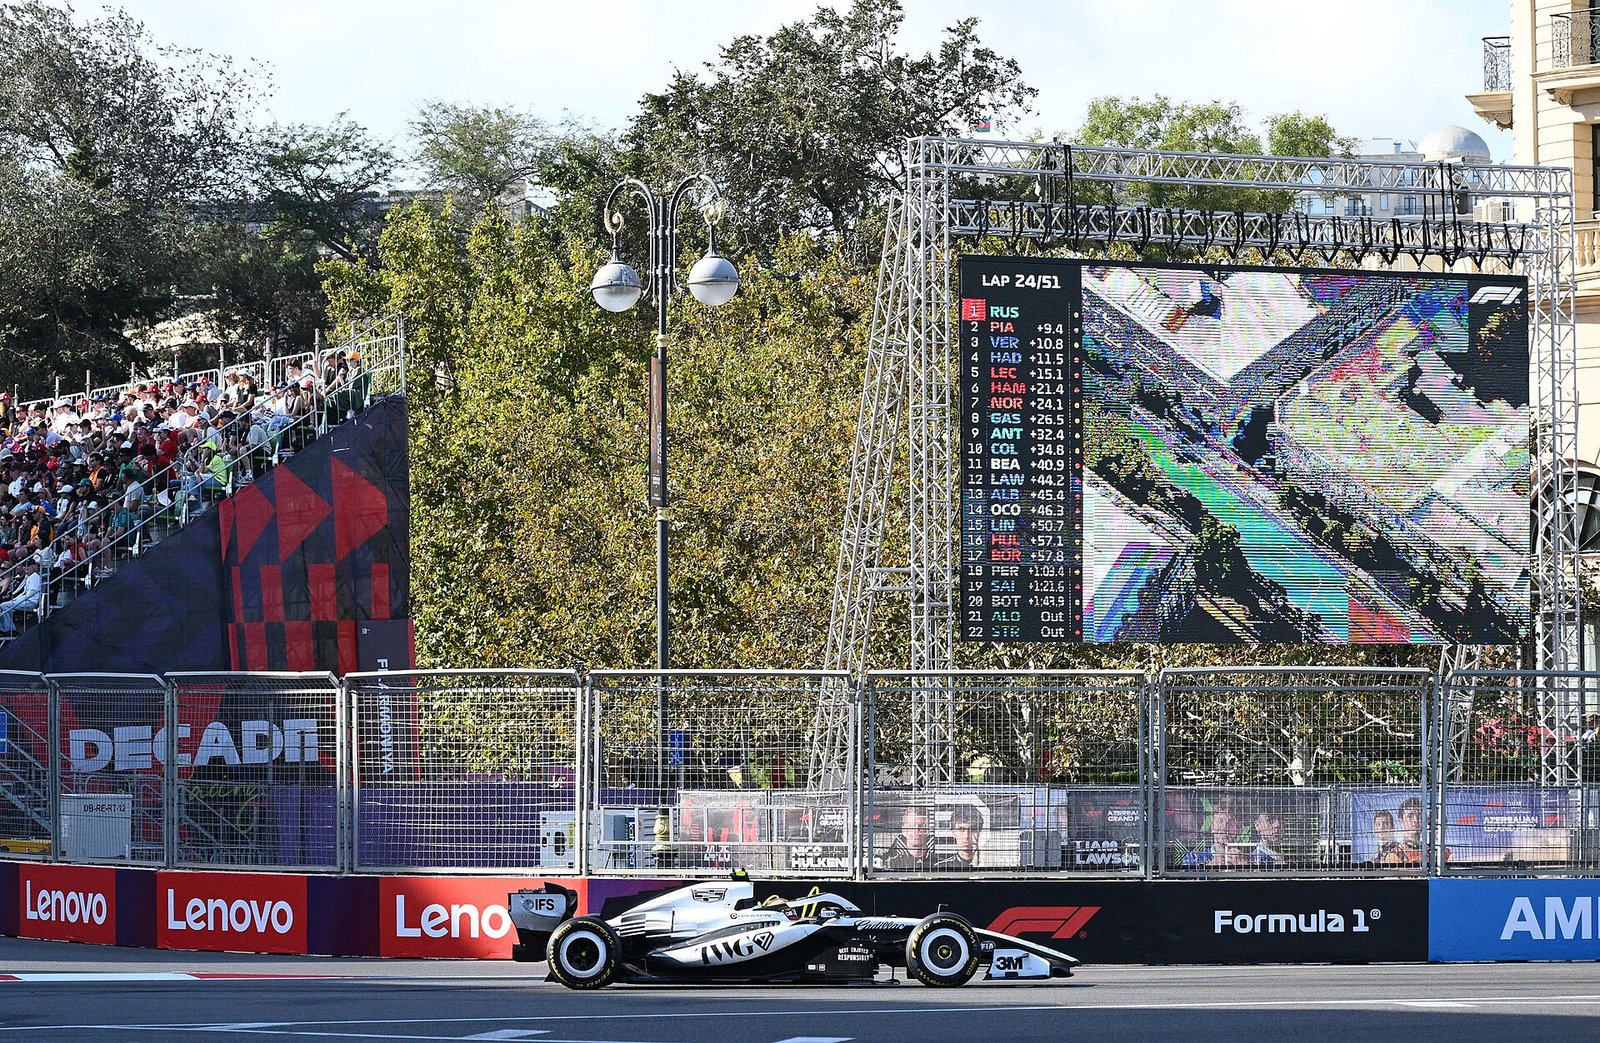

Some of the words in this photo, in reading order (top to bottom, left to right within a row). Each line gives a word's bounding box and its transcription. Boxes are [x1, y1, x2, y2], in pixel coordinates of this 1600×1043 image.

[981, 274, 1010, 286] LAP
[1014, 274, 1061, 289] 24/51
[1468, 286, 1523, 305] F1
[970, 306, 980, 317] 1
[990, 306, 1019, 318] RUS
[970, 321, 980, 332] 2
[990, 322, 1015, 333] PIA
[1037, 323, 1064, 334] +9.4
[970, 336, 980, 347] 3
[990, 337, 1020, 348] VER
[1030, 338, 1064, 349] +10.8
[970, 352, 980, 362] 4
[990, 352, 1022, 362] HAD
[1030, 354, 1064, 364] +11.5
[970, 366, 980, 378] 5
[990, 367, 1017, 378] LEC
[1030, 368, 1064, 380] +15.1
[970, 382, 980, 392] 6
[990, 382, 1026, 393] HAM
[1030, 382, 1064, 394] +21.4
[970, 397, 980, 408] 7
[990, 398, 1023, 408] NOR
[1030, 398, 1064, 410] +24.1
[970, 412, 980, 424] 8
[990, 413, 1021, 424] GAS
[1030, 414, 1064, 425] +26.5
[970, 428, 980, 438] 9
[990, 428, 1023, 439] ANT
[1030, 428, 1064, 440] +32.4
[968, 442, 983, 453] 10
[990, 443, 1018, 454] COL
[1030, 444, 1064, 454] +34.8
[968, 458, 983, 469] 11
[990, 458, 1020, 470] BEA
[1030, 459, 1064, 470] +40.9
[968, 474, 983, 484] 12
[990, 474, 1025, 485] LAW
[1030, 474, 1064, 486] +44.2
[968, 488, 983, 499] 13
[990, 489, 1019, 500] ALB
[1030, 490, 1064, 500] +45.4
[968, 504, 983, 515] 14
[990, 504, 1021, 516] OCO
[1030, 504, 1064, 516] +46.3
[968, 519, 983, 530] 15
[990, 520, 1014, 530] LIN
[1030, 520, 1064, 532] +50.7
[968, 534, 983, 544] 16
[990, 534, 1020, 545] HUL
[1030, 535, 1064, 546] +57.1
[968, 549, 983, 560] 17
[990, 550, 1022, 561] BOR
[1030, 550, 1064, 562] +57.8
[968, 566, 983, 576] 18
[990, 566, 1019, 576] PER
[968, 580, 983, 591] 19
[990, 580, 1015, 592] SAI
[968, 595, 983, 606] 20
[990, 596, 1022, 606] BOT
[968, 610, 983, 620] 21
[990, 611, 1020, 621] ALO
[1040, 612, 1064, 622] Out
[968, 626, 983, 636] 22
[1040, 626, 1064, 638] Out
[26, 880, 107, 926] Lenovo
[535, 898, 555, 911] IFS
[167, 888, 294, 934] Lenovo
[396, 894, 512, 939] Leno
[985, 906, 1102, 939] F1
[1214, 909, 1345, 934] Formula
[1500, 896, 1600, 940] AM
[854, 920, 906, 931] Cadillac
[981, 942, 995, 951] FIA
[995, 956, 1024, 971] 3M
